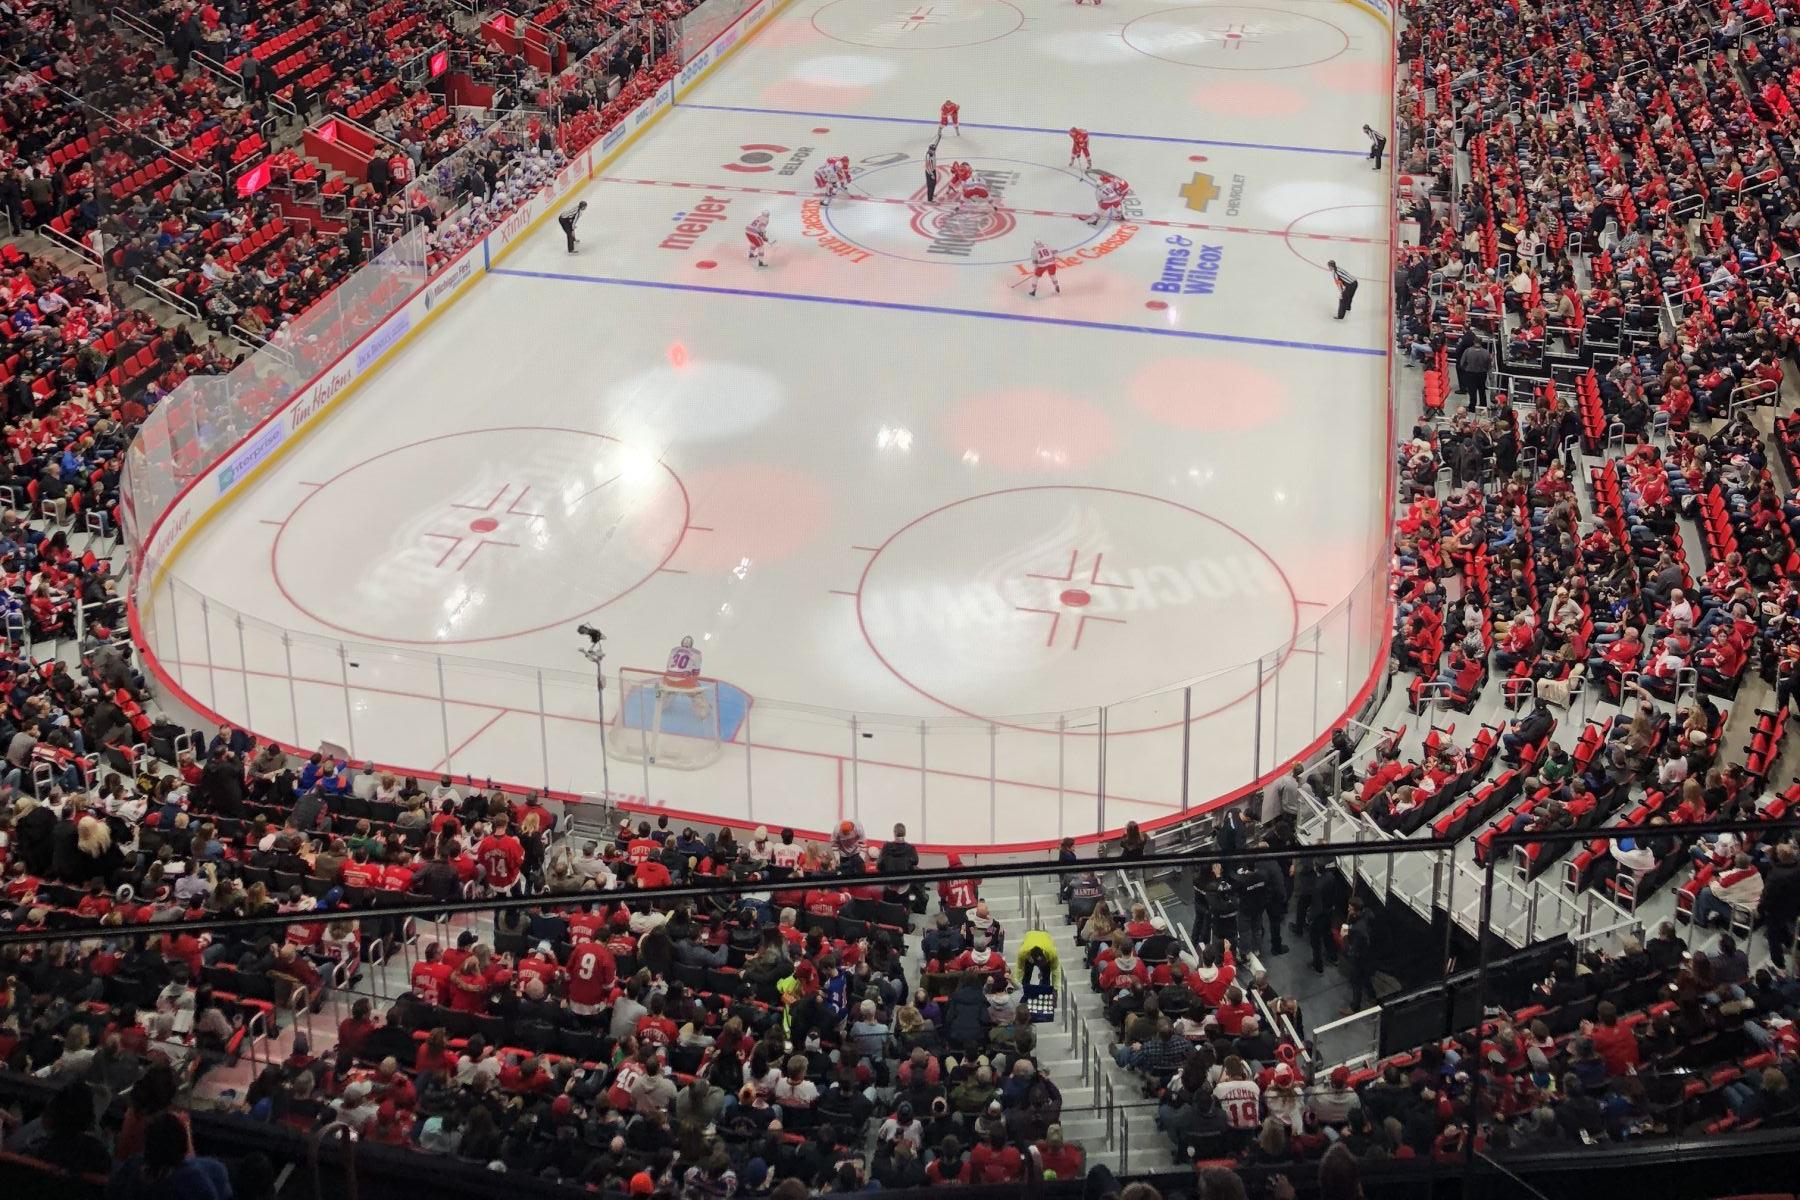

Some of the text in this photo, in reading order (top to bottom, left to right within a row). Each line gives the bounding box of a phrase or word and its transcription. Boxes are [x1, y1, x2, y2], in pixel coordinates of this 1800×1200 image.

[777, 146, 816, 176] BELFOR
[1225, 173, 1246, 217] CHEVROLET
[500, 203, 533, 244] xfinity
[658, 195, 734, 250] meijer
[1150, 234, 1194, 295] Burns &
[1182, 243, 1224, 295] Wilcox
[289, 368, 352, 431] Tim Hortons
[490, 856, 507, 878] 14
[951, 885, 972, 907] 71
[578, 952, 596, 981] 9
[616, 1067, 640, 1093] 40
